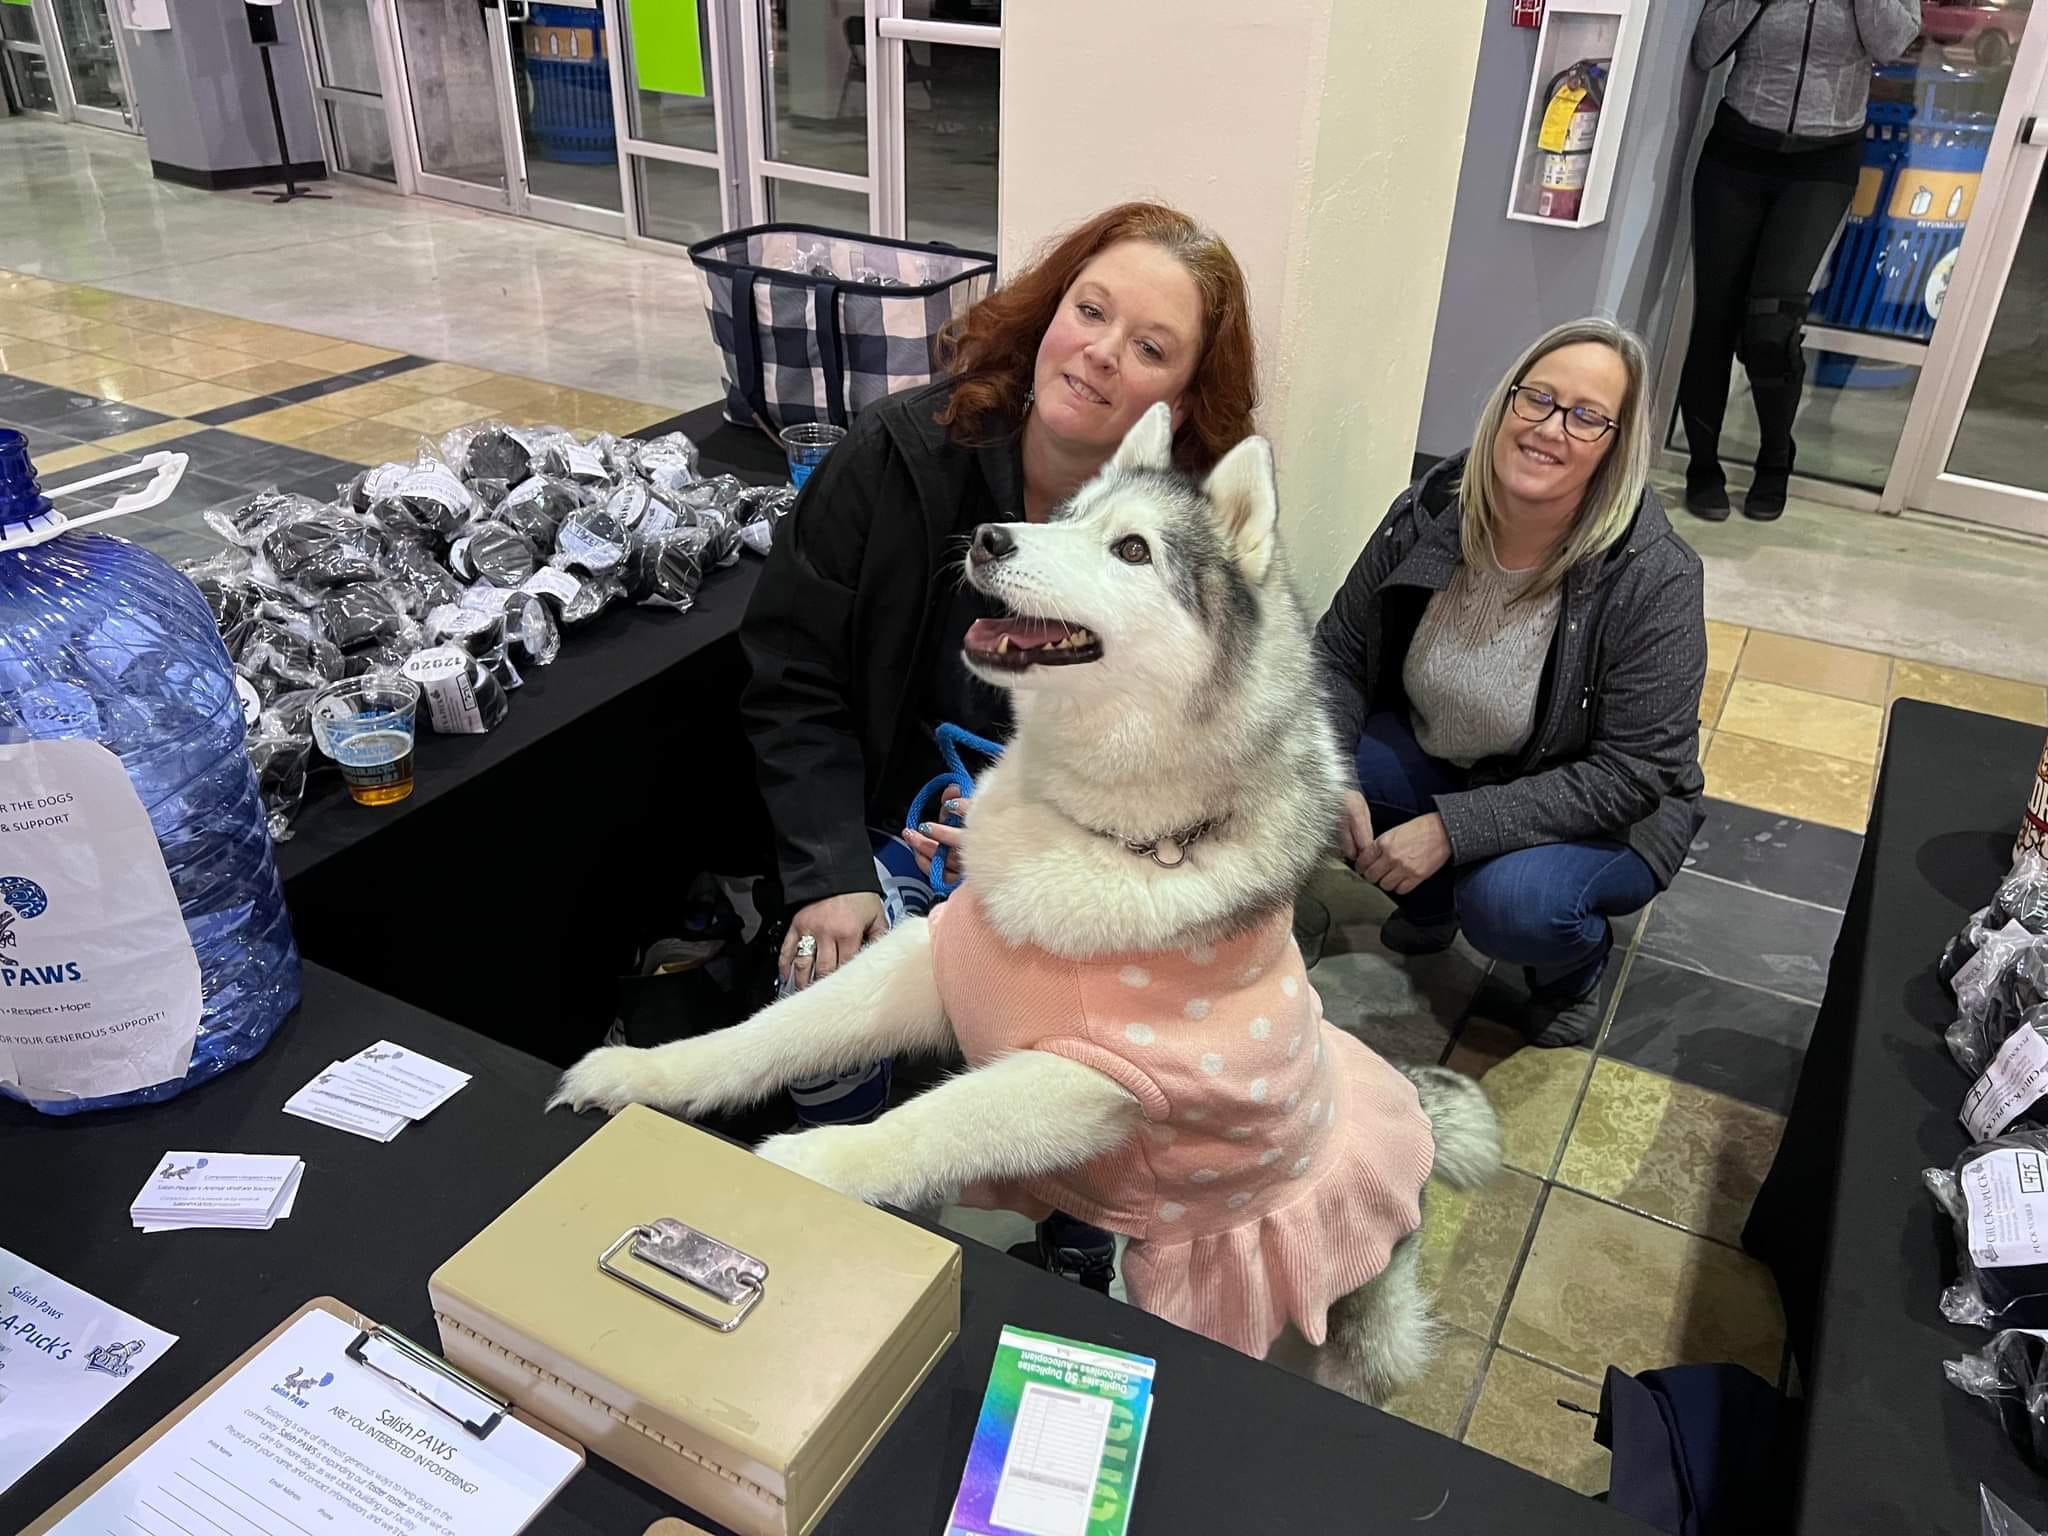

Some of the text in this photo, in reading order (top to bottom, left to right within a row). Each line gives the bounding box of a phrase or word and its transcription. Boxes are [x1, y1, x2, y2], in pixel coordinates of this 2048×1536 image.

[9, 800, 35, 812] THE
[37, 792, 74, 808] DOGS
[13, 813, 70, 832] SUPPORT
[1, 961, 82, 987] PAWS
[11, 1005, 52, 1017] Respect
[60, 1001, 92, 1014] Hope
[15, 1035, 43, 1045] YOUR
[45, 1027, 107, 1045] GENEROUS
[108, 1010, 166, 1034] SUPPORT!
[8, 1286, 64, 1320] Salish Paws
[0, 1314, 72, 1360] A-Puck's
[277, 1427, 297, 1443] Salish
[295, 1438, 317, 1455] PAWS
[375, 1408, 458, 1460] Salish PAWS
[328, 1405, 348, 1420] ARE
[345, 1414, 368, 1431] YOU
[364, 1426, 417, 1459] INTERESTED
[423, 1460, 479, 1495] FOSTERING?
